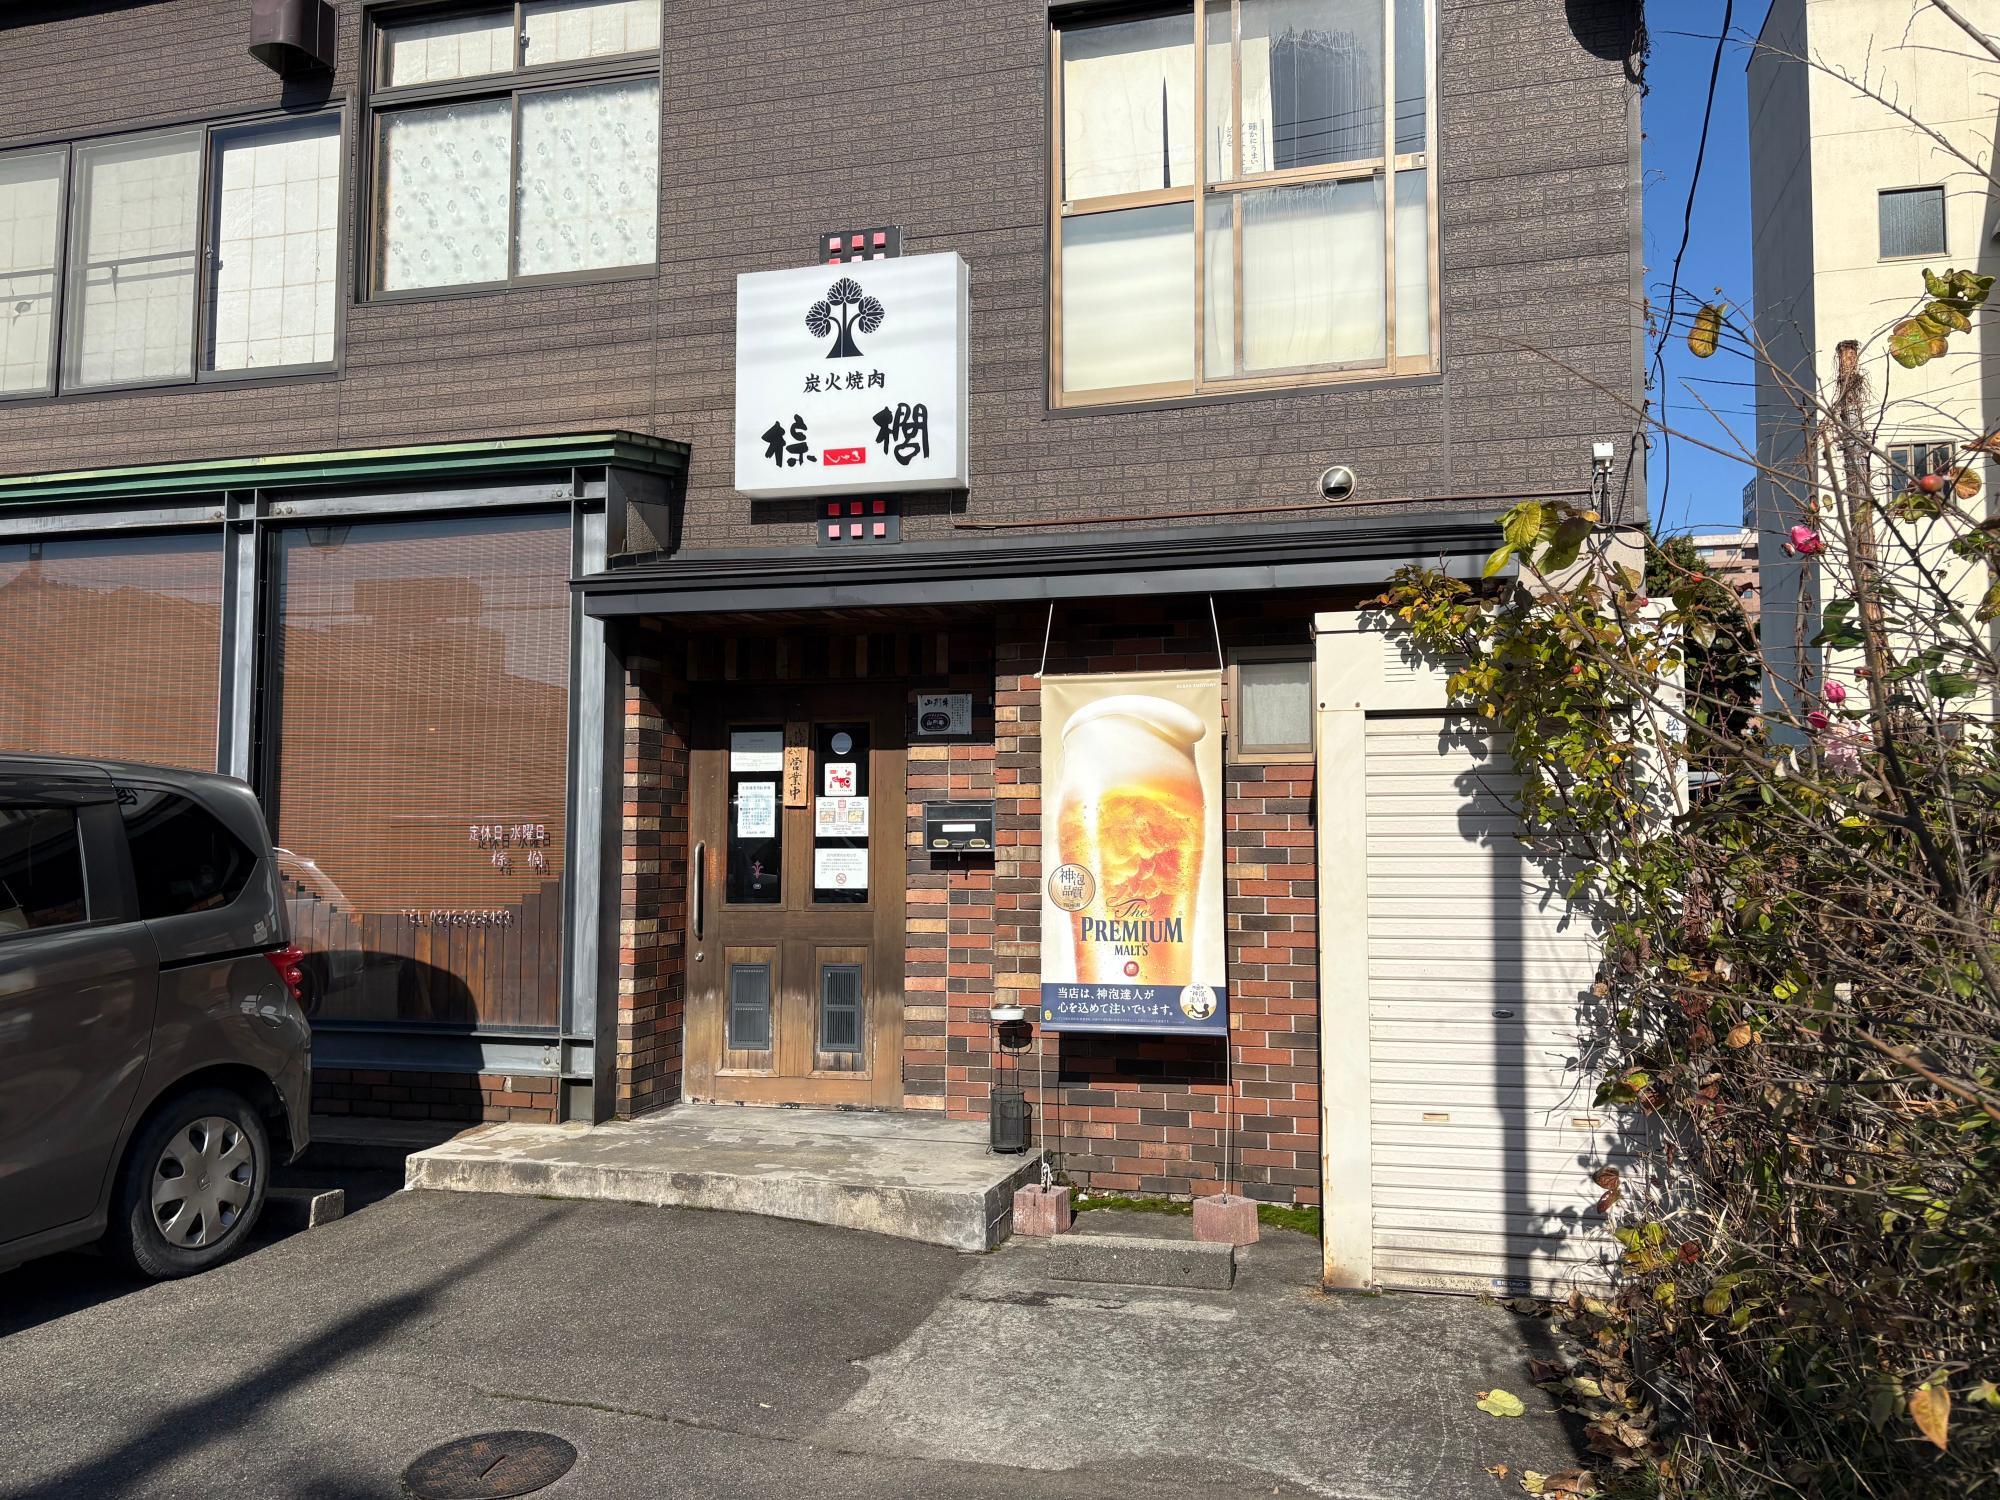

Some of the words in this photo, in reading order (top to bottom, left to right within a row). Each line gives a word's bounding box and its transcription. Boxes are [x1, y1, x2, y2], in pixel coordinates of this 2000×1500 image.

[803, 369, 886, 393] 炭火焼肉
[825, 451, 861, 464] しゅろ
[469, 825, 502, 840] 定休日
[510, 824, 544, 840] 水曜日
[1060, 867, 1085, 885] 神泡
[1062, 886, 1082, 898] 品質
[1106, 897, 1156, 918] The
[401, 909, 424, 923] TEL
[1081, 916, 1183, 943] PREMIUM
[1114, 943, 1149, 956] MALT'S
[1057, 987, 1154, 1001] 当店は、神泡達人が
[1057, 1002, 1173, 1016] 心を込めて注いでいます。
